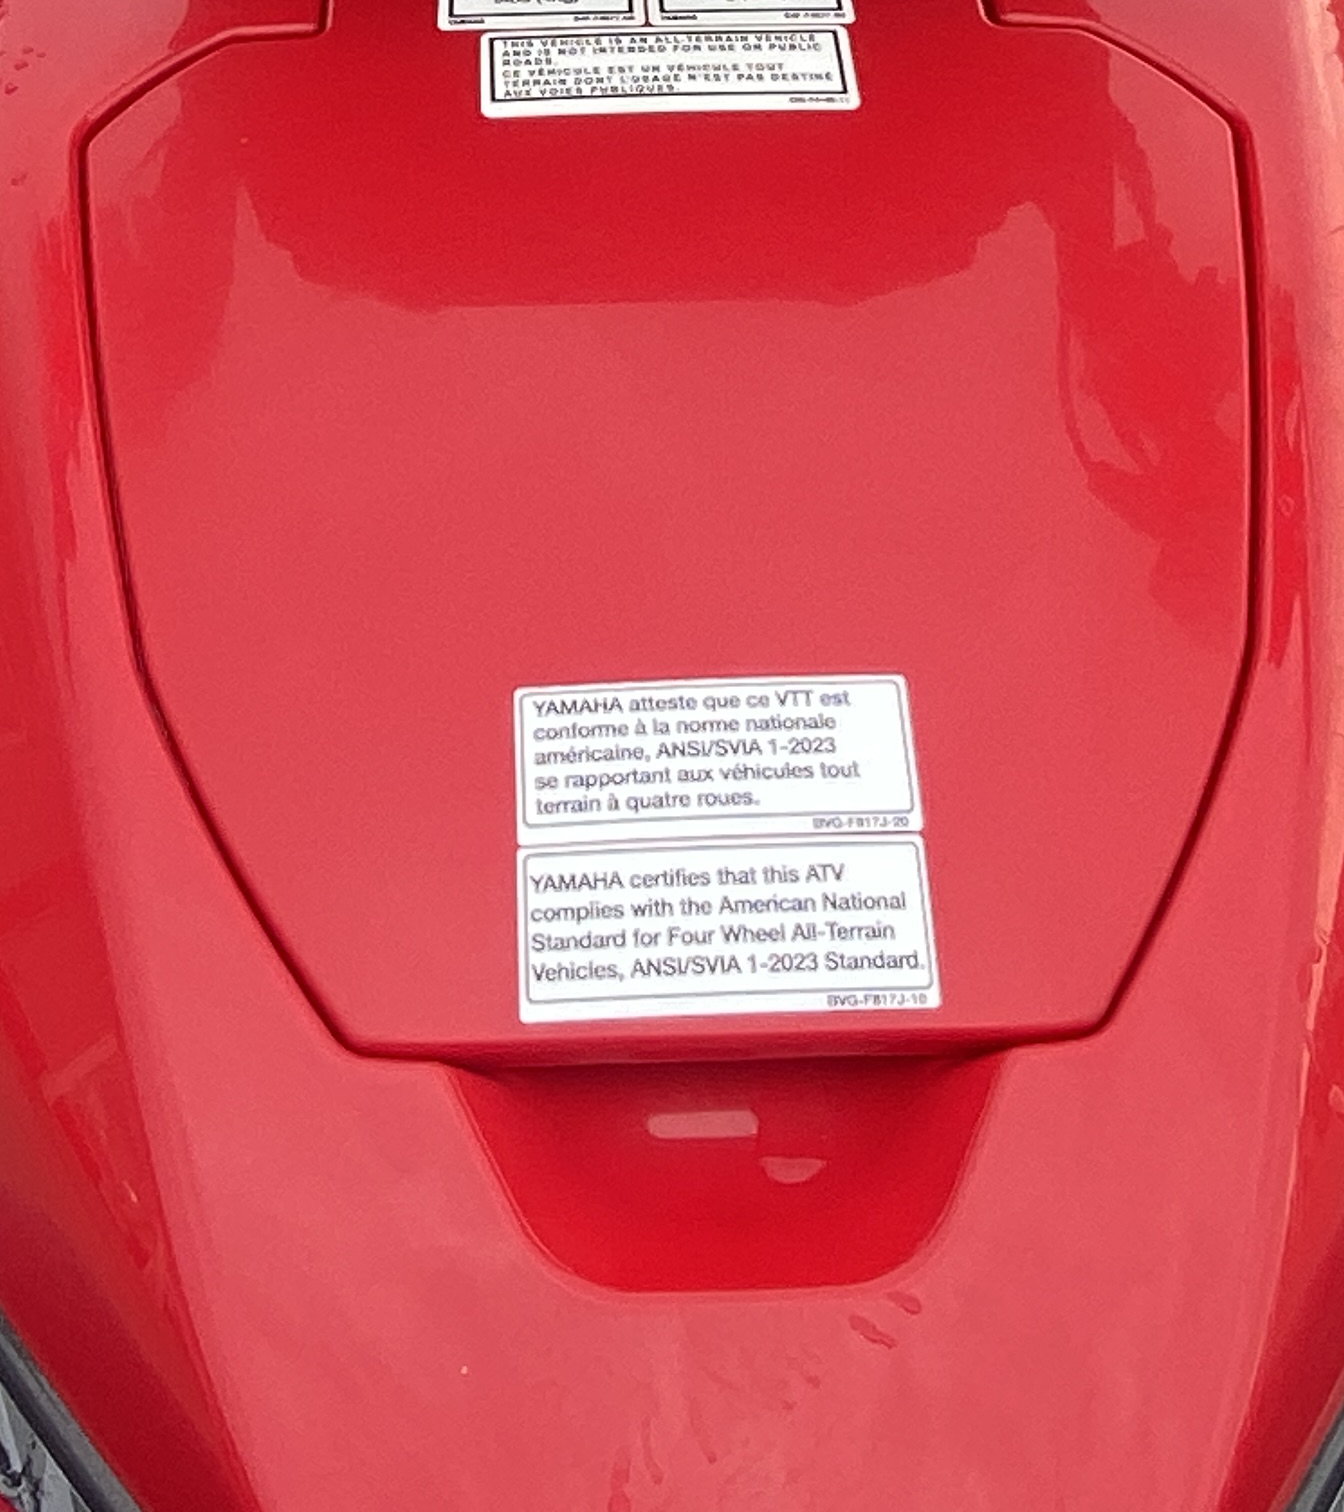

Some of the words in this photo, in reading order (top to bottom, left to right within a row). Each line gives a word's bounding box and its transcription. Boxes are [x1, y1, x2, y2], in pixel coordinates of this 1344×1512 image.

[533, 697, 623, 717] YAMAHA
[628, 695, 697, 712] atteste
[702, 695, 741, 711] que
[745, 694, 770, 708] ce
[774, 689, 814, 706] VTT
[819, 690, 850, 706] est
[533, 721, 629, 741] conforme
[634, 718, 647, 736] à
[652, 718, 669, 735] la
[676, 718, 739, 733] norme
[744, 711, 836, 732] nationale
[534, 742, 651, 766] américaine,
[655, 738, 763, 759] ANSI/SVIA
[768, 735, 836, 755] 1-2023
[534, 774, 557, 790] se
[565, 767, 671, 792] rapportant
[677, 768, 714, 783] aux
[718, 761, 814, 782] véhicules
[819, 761, 861, 779] tout
[535, 795, 601, 815] terrain
[607, 794, 619, 811] à
[625, 791, 690, 812] quatre
[696, 789, 759, 808] roues.
[530, 872, 623, 892] YAMAHA
[628, 867, 710, 888] certifies
[716, 866, 756, 885] that
[762, 864, 799, 883] this
[804, 863, 846, 882] ATV
[531, 901, 624, 924] complies
[630, 898, 673, 918] with
[679, 896, 712, 916] the
[717, 893, 816, 915] American
[821, 890, 907, 912] National
[531, 929, 626, 952] Standard
[632, 928, 659, 947] for
[667, 926, 714, 946] Four
[720, 923, 786, 944] Wheel
[789, 919, 896, 942] All-Terrain
[532, 959, 624, 984] Vehicles,
[629, 954, 741, 978] ANSI/SVIA
[747, 952, 818, 973] 1-2023
[823, 948, 925, 973] Standard.
